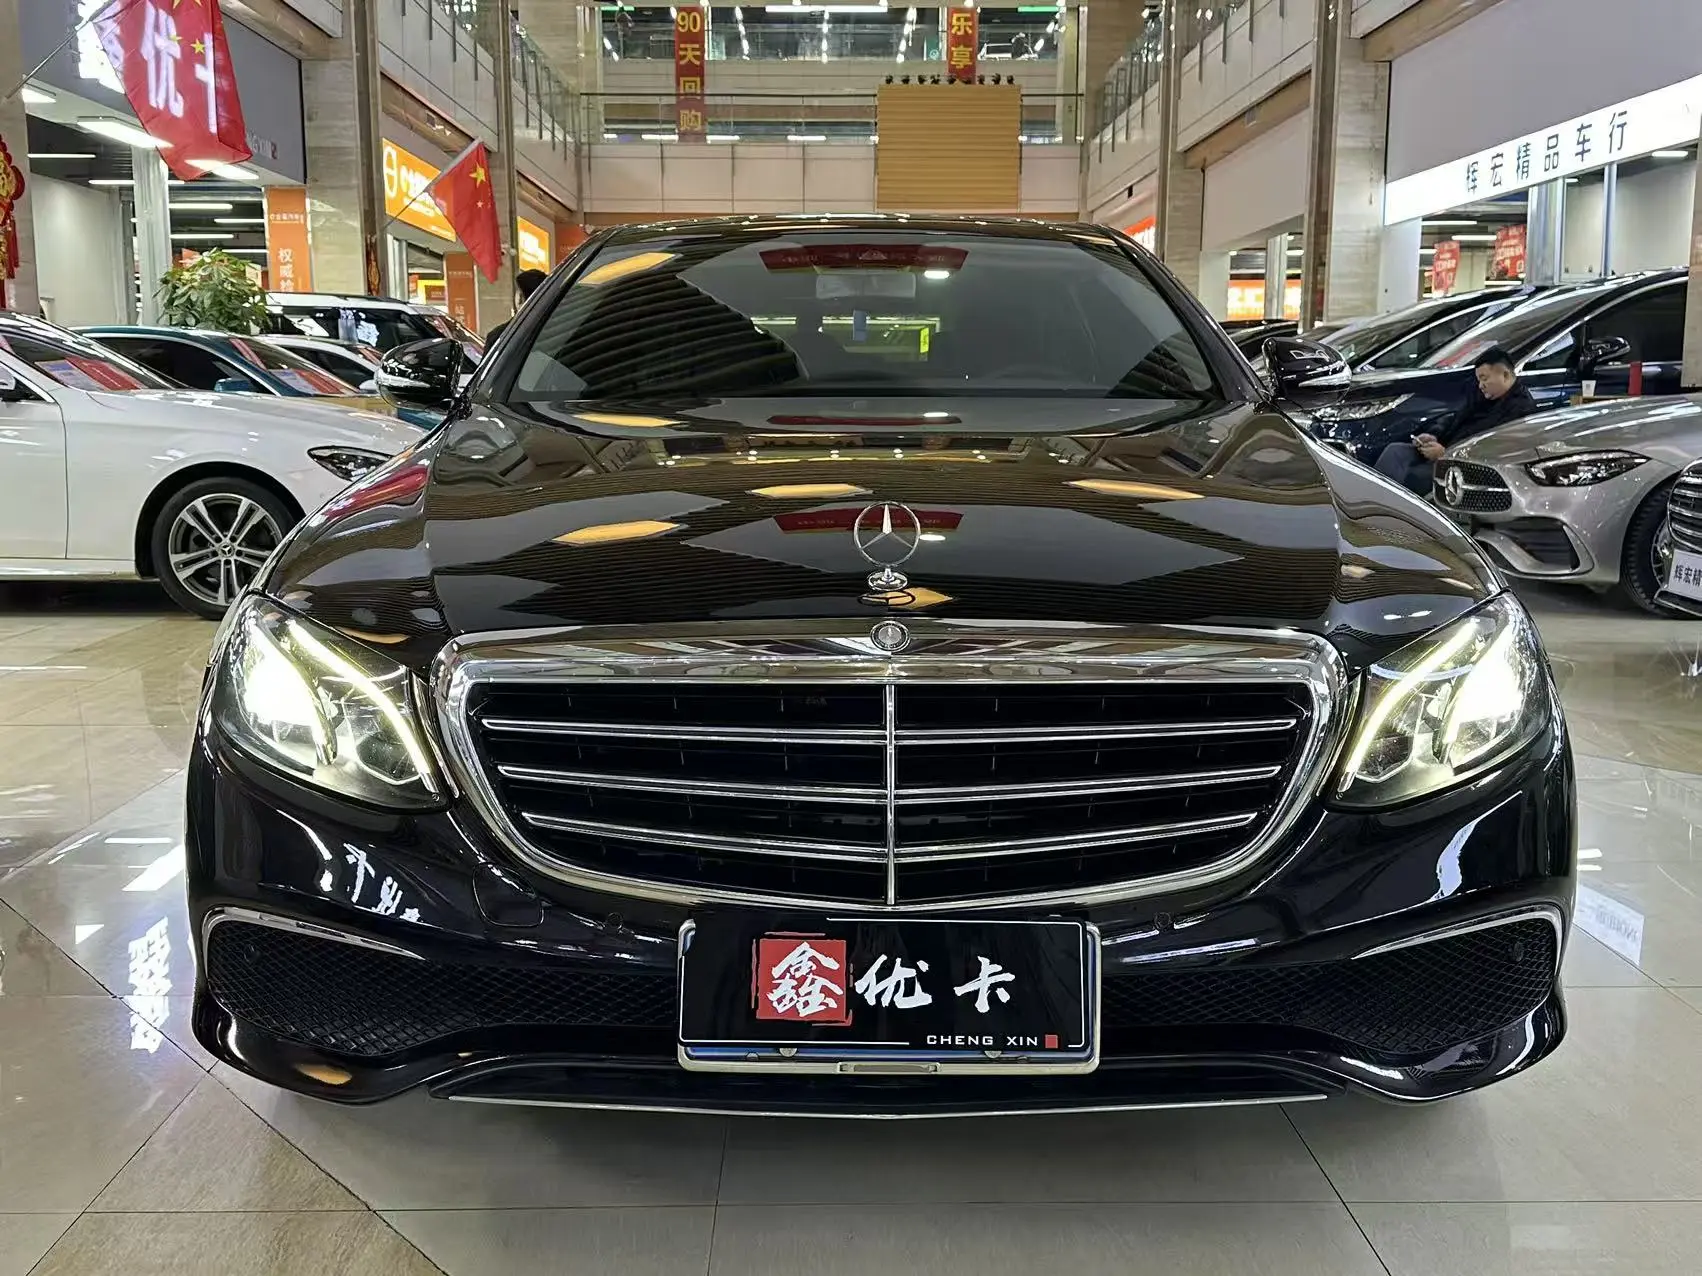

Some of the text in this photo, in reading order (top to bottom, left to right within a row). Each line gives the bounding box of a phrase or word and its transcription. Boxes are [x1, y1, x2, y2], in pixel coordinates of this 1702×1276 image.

[951, 13, 973, 69] 乐享
[1466, 110, 1628, 194] 辉宏精品车行
[766, 941, 1016, 1016] 鑫优卡
[926, 1034, 1038, 1047] CHENG XIN
